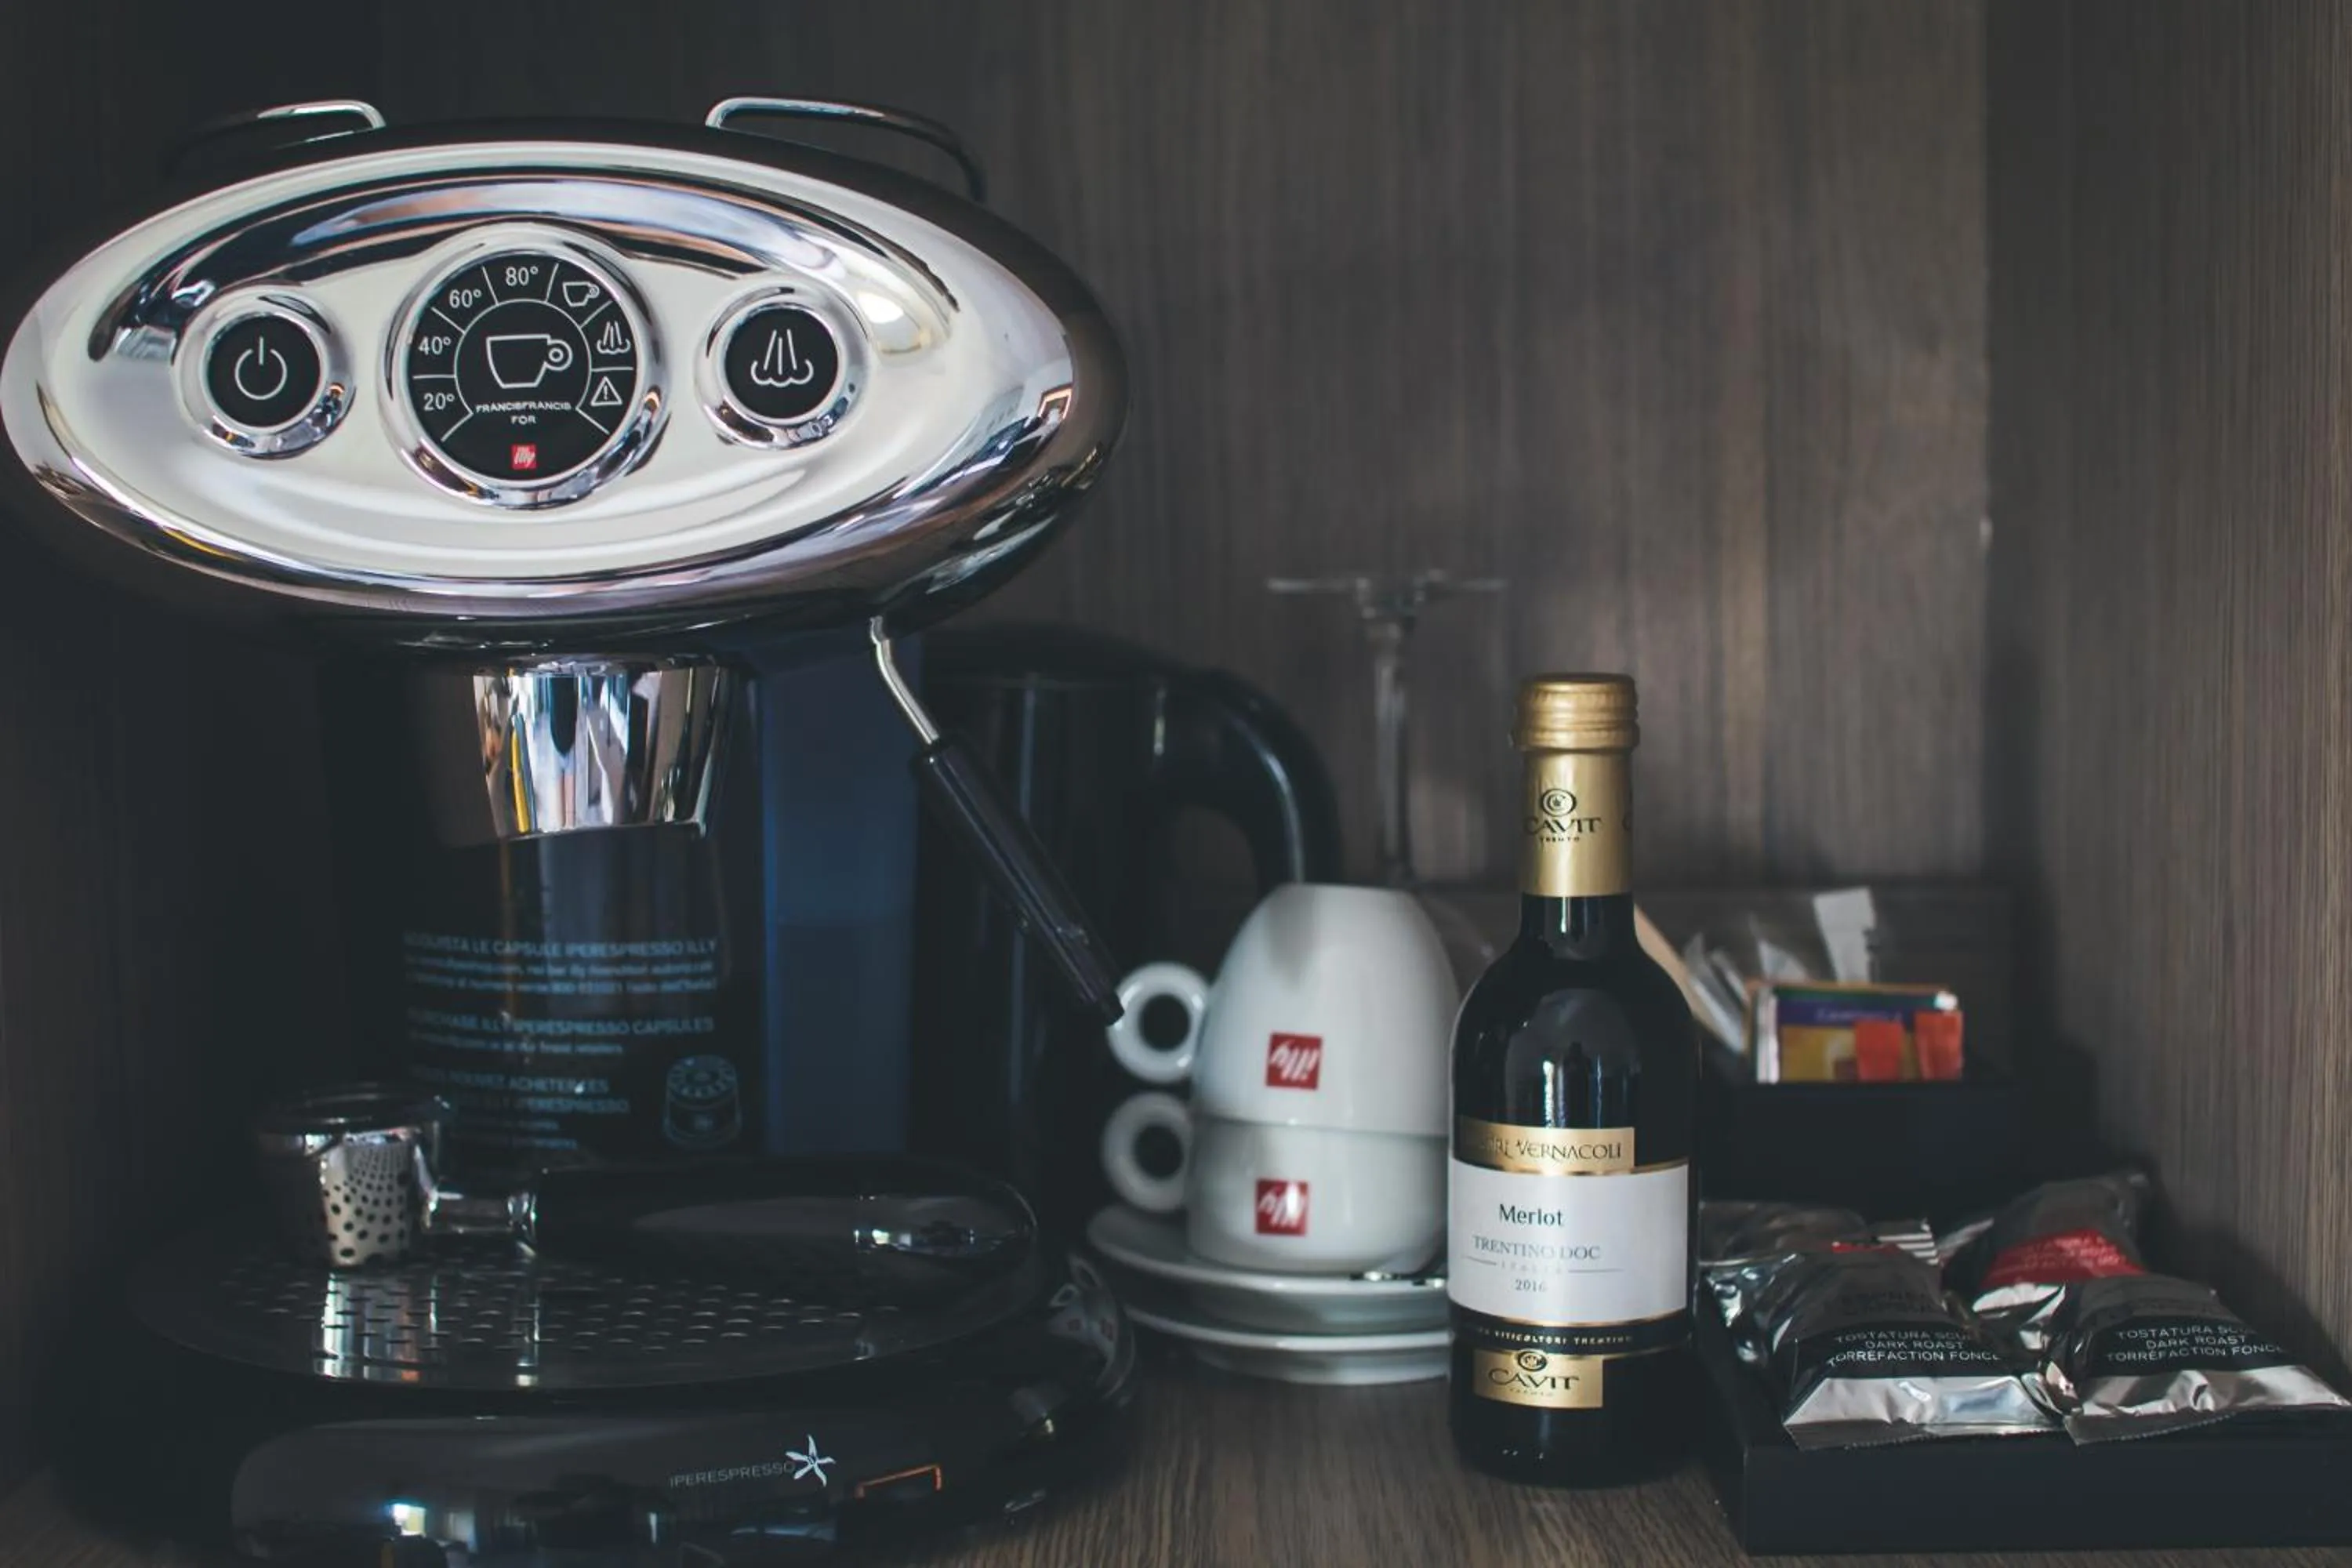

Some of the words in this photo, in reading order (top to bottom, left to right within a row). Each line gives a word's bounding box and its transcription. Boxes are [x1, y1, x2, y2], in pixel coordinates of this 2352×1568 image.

[511, 415, 536, 425] FOR
[1523, 816, 1602, 837] CAVIT
[1499, 1203, 1564, 1228] Merlot
[1472, 1235, 1554, 1260] TRENTINO
[1559, 1244, 1602, 1260] DOC
[1515, 1278, 1548, 1293] 2016
[1835, 1331, 1932, 1343] TOSTATURA
[2118, 1325, 2214, 1340] TOSTATURA
[1865, 1340, 1907, 1349] DARK
[1912, 1340, 1964, 1350] ROAST
[2146, 1338, 2190, 1350] DARK
[2195, 1334, 2247, 1345] ROAST
[1488, 1368, 1580, 1391] CAVIT
[670, 1461, 796, 1488] IPERESPRESSO
